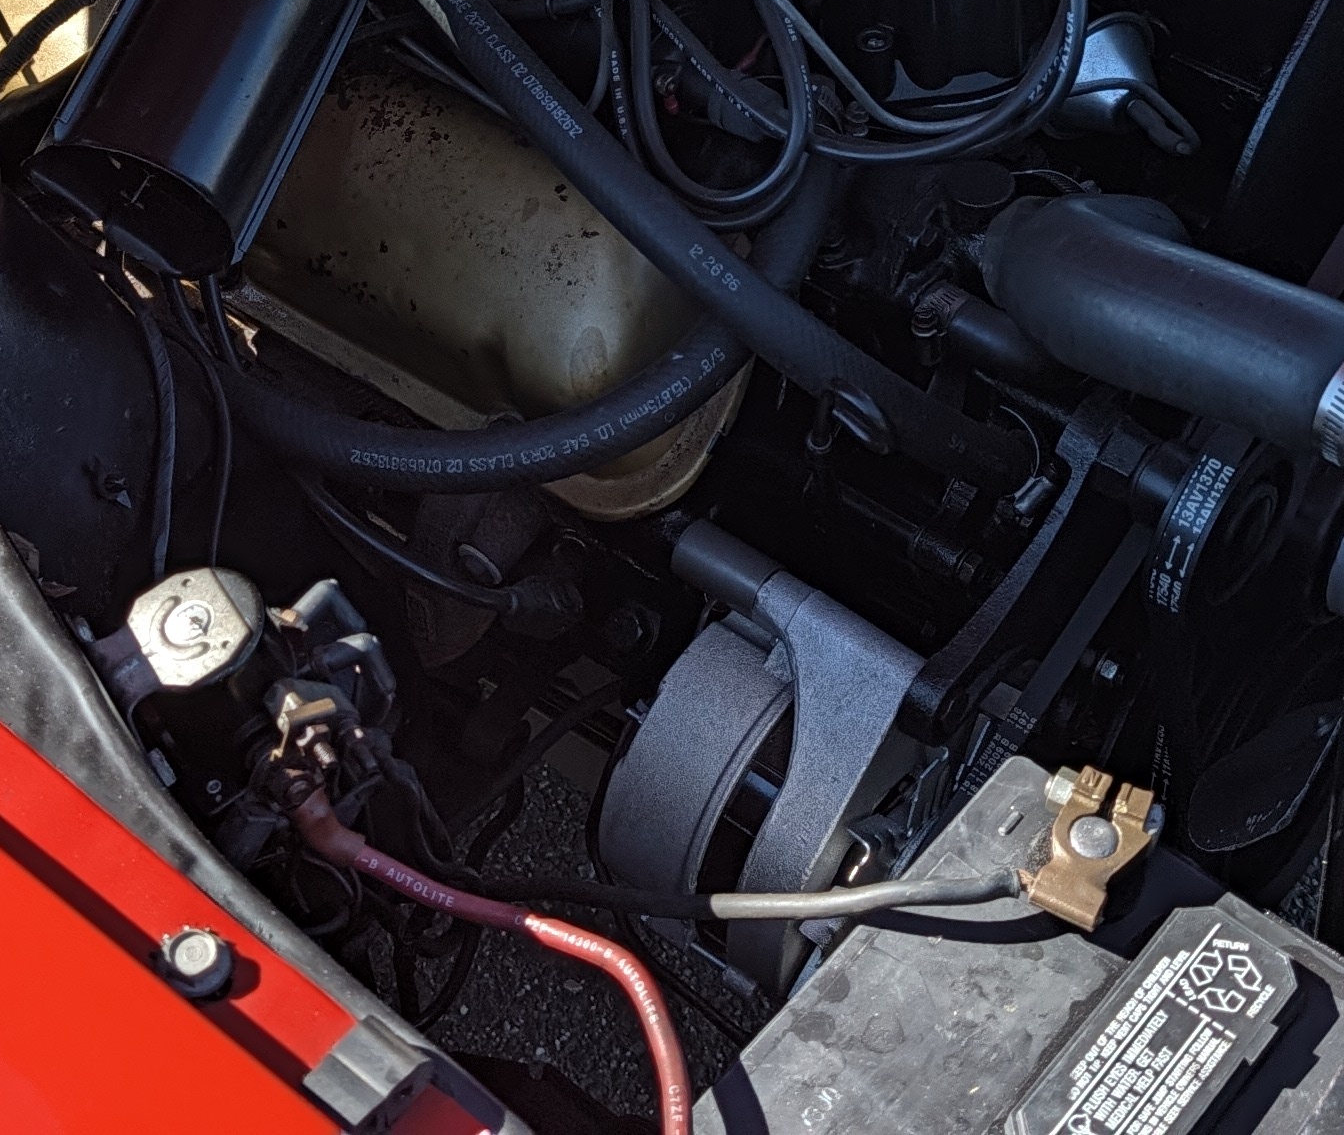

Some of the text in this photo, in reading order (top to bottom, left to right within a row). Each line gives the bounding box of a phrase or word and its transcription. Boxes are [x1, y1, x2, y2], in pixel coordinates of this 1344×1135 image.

[464, 9, 490, 36] 20R3
[484, 32, 515, 64] CLASS
[1059, 11, 1074, 74] TAYLOR
[610, 50, 620, 81] MADE
[614, 87, 622, 99] IN
[687, 242, 742, 293] 12 26 96
[622, 377, 690, 427] (15.875mm)
[469, 449, 515, 474] CLASS
[519, 442, 555, 465] 20R3
[559, 432, 590, 454] SAE
[1178, 458, 1222, 528] 13AV1370
[1155, 572, 1171, 605] 17540
[983, 745, 1005, 771] 2009
[1008, 742, 1019, 752] B
[385, 865, 455, 909] AUTOLITE
[1212, 938, 1250, 951] RETURN
[615, 957, 659, 1025] AUTOLITE
[1085, 1045, 1099, 1061] OUT
[1105, 1020, 1119, 1034] THE
[1116, 998, 1137, 1021] REACH
[1143, 956, 1170, 988] CHILDREN
[1179, 978, 1197, 1001] LEAD
[1246, 983, 1276, 1018] RECYCLE
[1077, 1072, 1091, 1087] NOT
[1101, 1039, 1117, 1057] KEEP
[1115, 1021, 1131, 1039] VENT
[1129, 1002, 1146, 1022] CAPS
[1142, 983, 1161, 1003] TIGHT
[1159, 968, 1173, 984] AND
[1170, 949, 1189, 969] LEVEL
[1082, 1010, 1167, 1113] FLUSH EYES IMMEDIATELY
[1092, 1095, 1116, 1121] WITH
[1136, 1048, 1154, 1067] GET
[1138, 1103, 1154, 1121] SAFE
[1152, 1085, 1169, 1104] JUMP
[1166, 1053, 1193, 1086] STARTING
[1189, 1028, 1212, 1054] FOLLOW
[1105, 1047, 1173, 1128] MEDICAL HELP FAST
[1156, 1090, 1178, 1116] VEHICLE
[1176, 1061, 1200, 1090] OWNERS
[1166, 1106, 1181, 1123] SEEK
[1179, 1079, 1201, 1105] SERVICE
